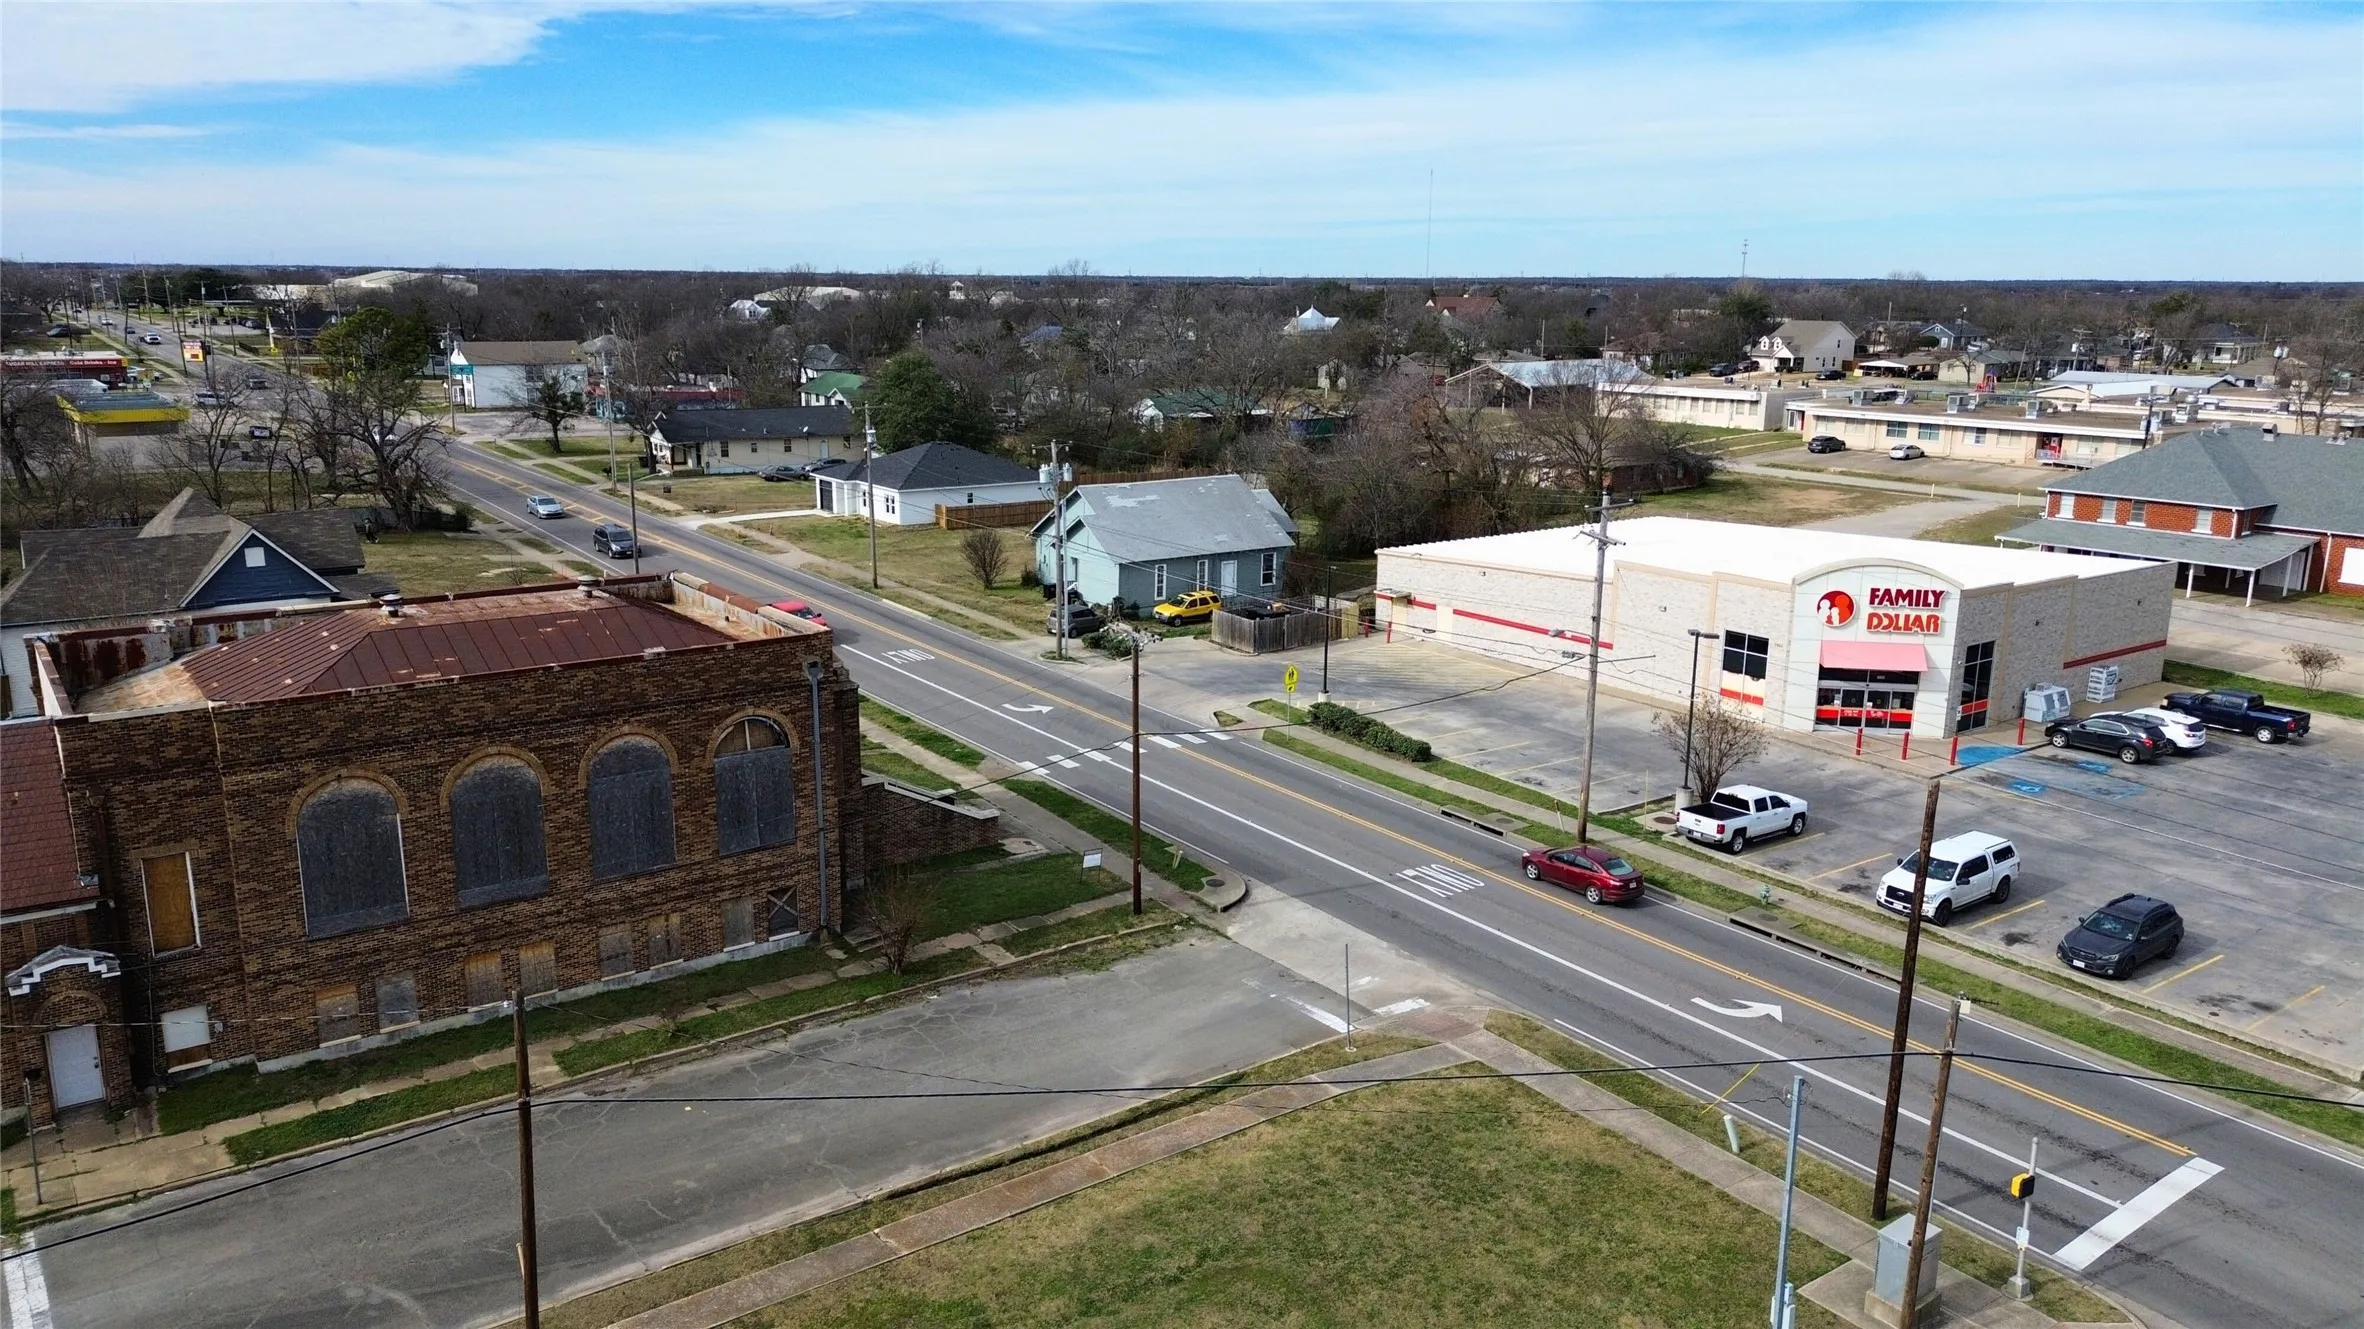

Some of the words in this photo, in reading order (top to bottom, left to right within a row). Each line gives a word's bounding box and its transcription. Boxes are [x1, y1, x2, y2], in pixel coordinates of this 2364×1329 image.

[1869, 588, 1945, 608] FAMILY
[1867, 612, 1940, 633] DOLLAR
[881, 649, 935, 664] ONLY
[1396, 864, 1485, 897] ONLY
